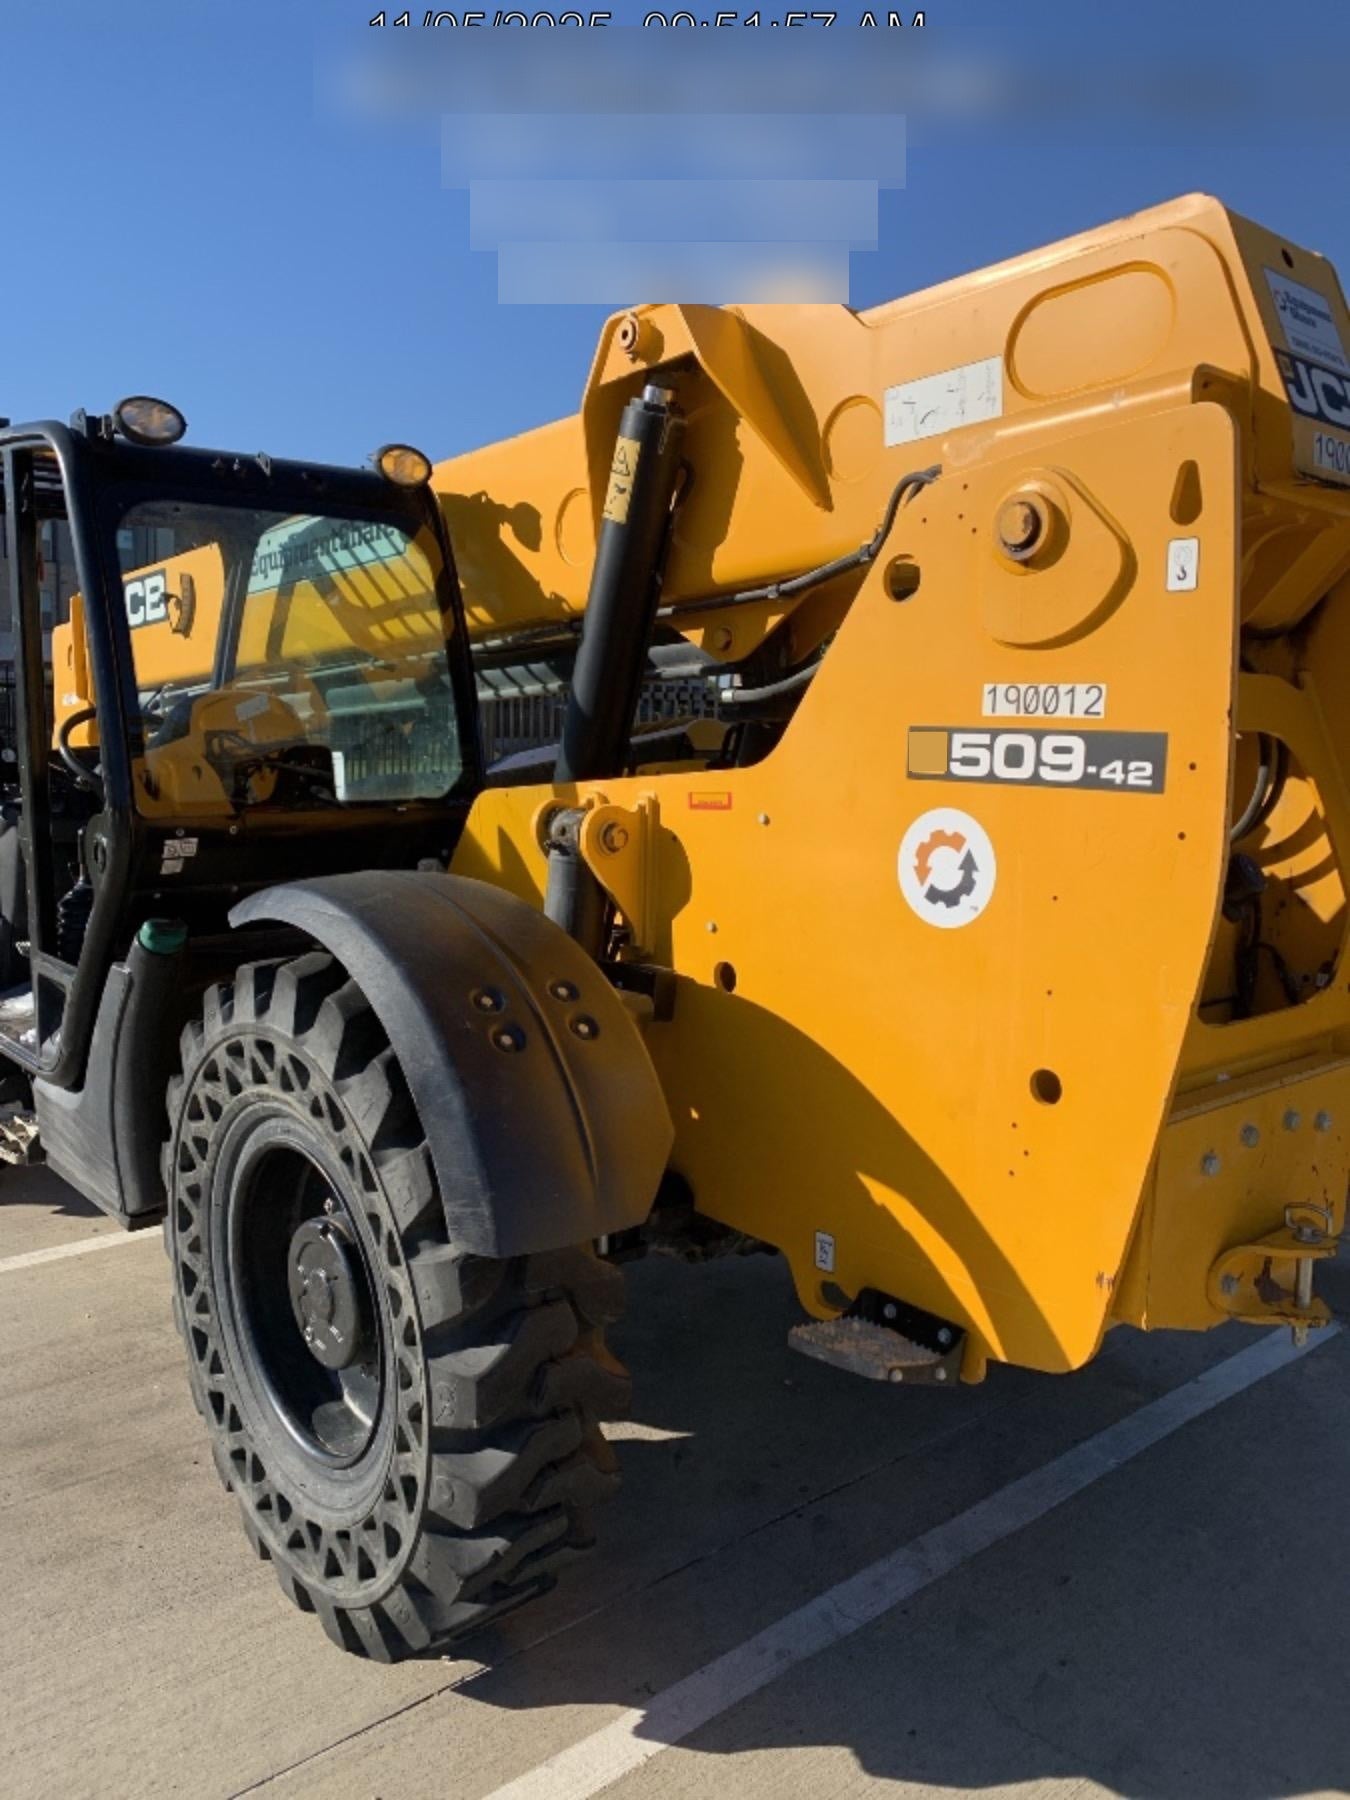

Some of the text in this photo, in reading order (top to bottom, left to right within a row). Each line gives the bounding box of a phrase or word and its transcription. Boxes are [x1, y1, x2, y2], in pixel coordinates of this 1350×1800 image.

[125, 574, 167, 626] CB
[987, 685, 1104, 716] 190012
[950, 733, 1153, 786] 509-42
